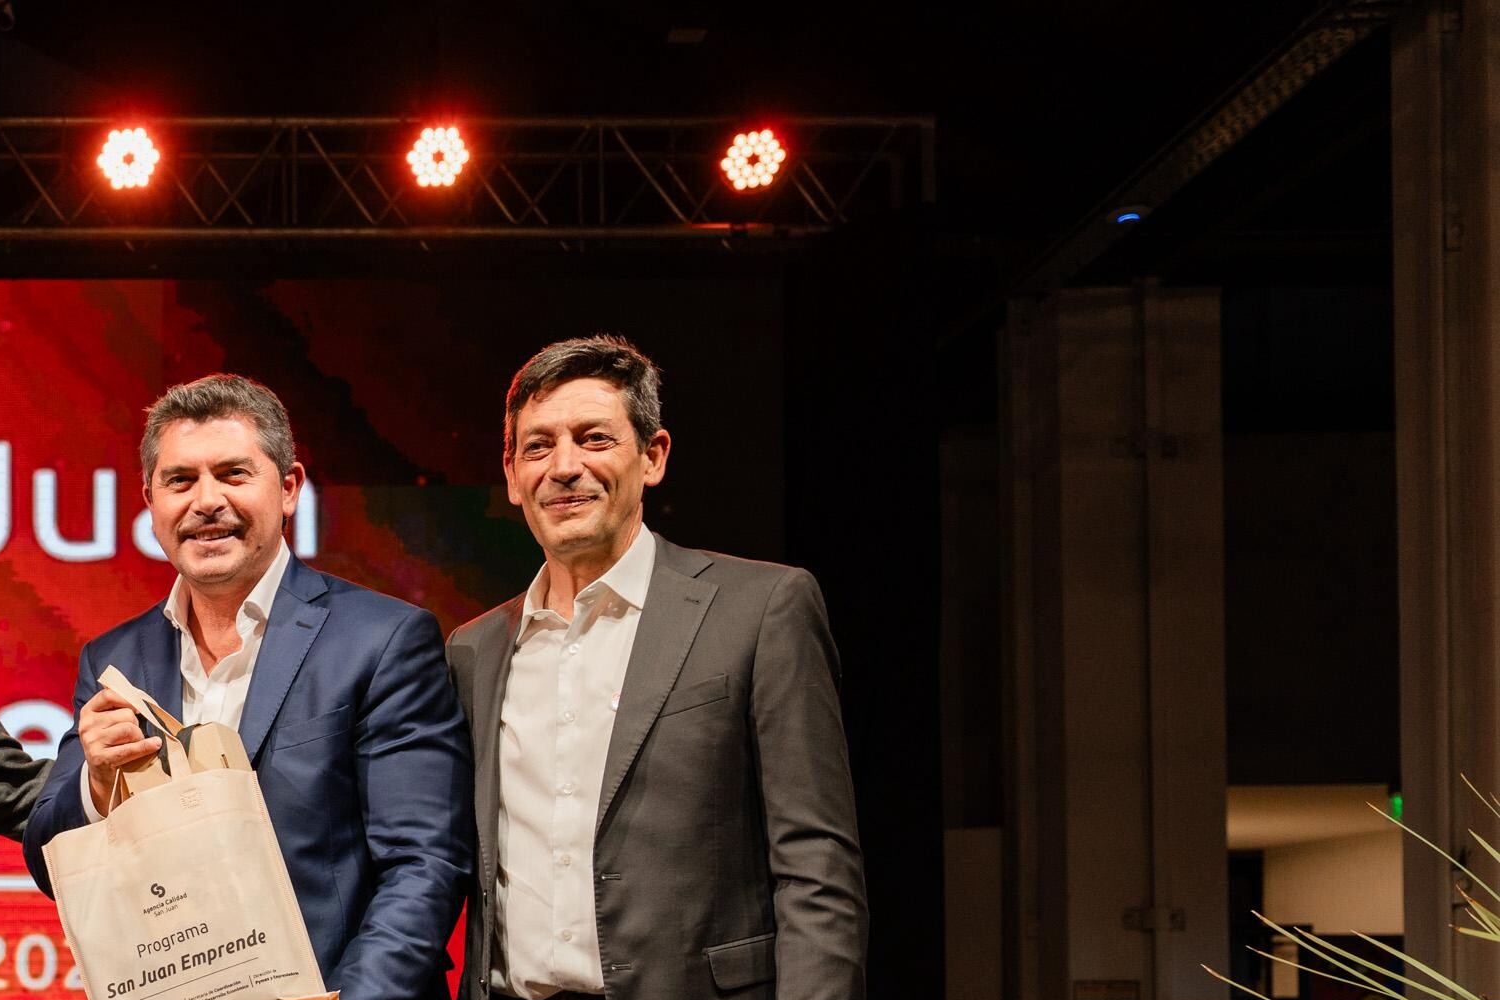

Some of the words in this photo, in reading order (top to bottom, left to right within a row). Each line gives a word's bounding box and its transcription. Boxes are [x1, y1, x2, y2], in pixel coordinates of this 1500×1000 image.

[143, 902, 164, 915] Agencia
[165, 892, 188, 905] Calidad
[154, 908, 165, 917] San
[166, 904, 179, 913] Juan
[136, 922, 209, 958] Programa
[107, 978, 136, 999] San
[139, 962, 177, 988] Juan
[180, 928, 267, 971] Emprende
